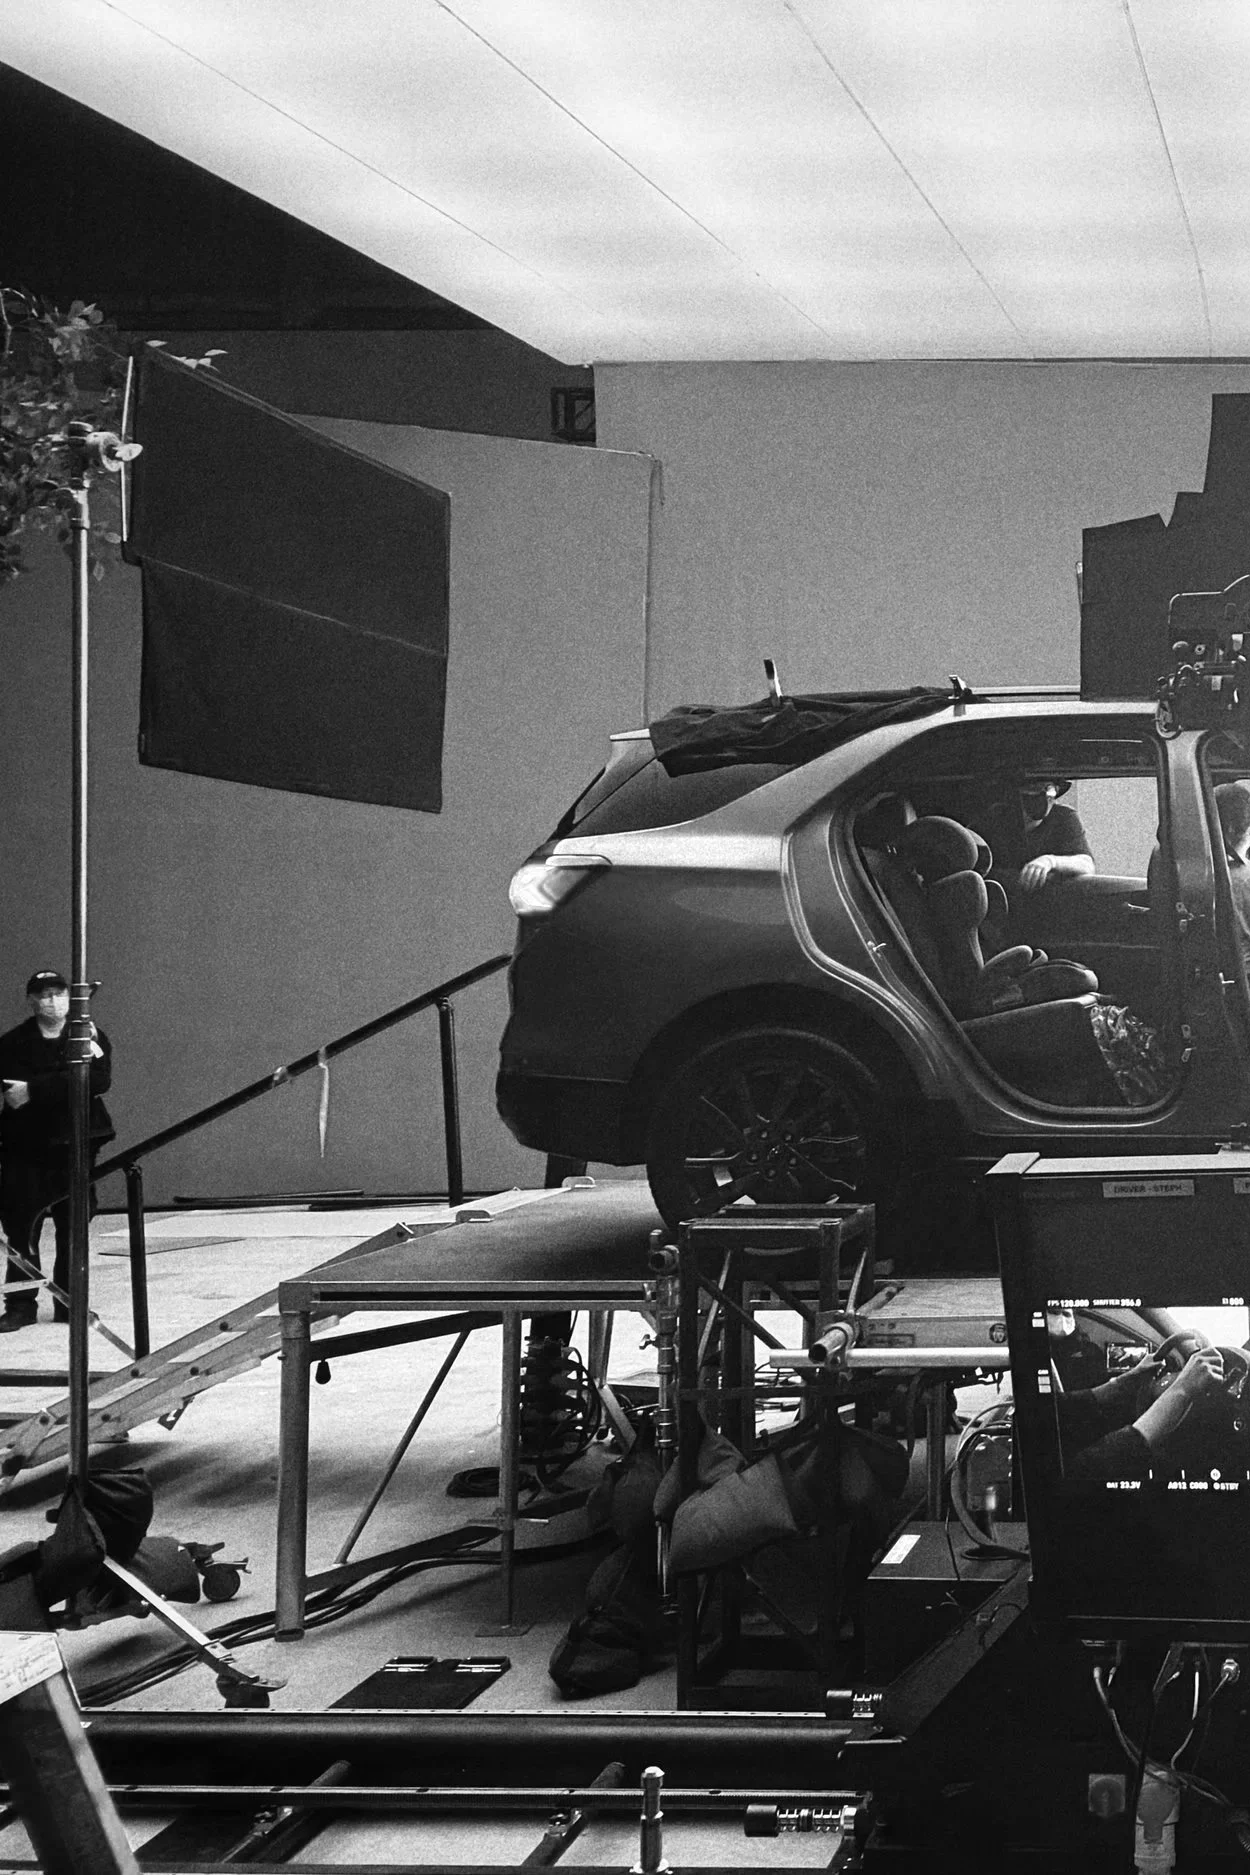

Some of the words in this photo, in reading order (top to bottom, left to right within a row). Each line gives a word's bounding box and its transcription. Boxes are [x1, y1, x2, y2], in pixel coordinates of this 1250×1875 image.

[1114, 1185, 1146, 1194] DRIVER
[1154, 1184, 1182, 1193] STEPH
[1060, 1299, 1089, 1307] 120.000
